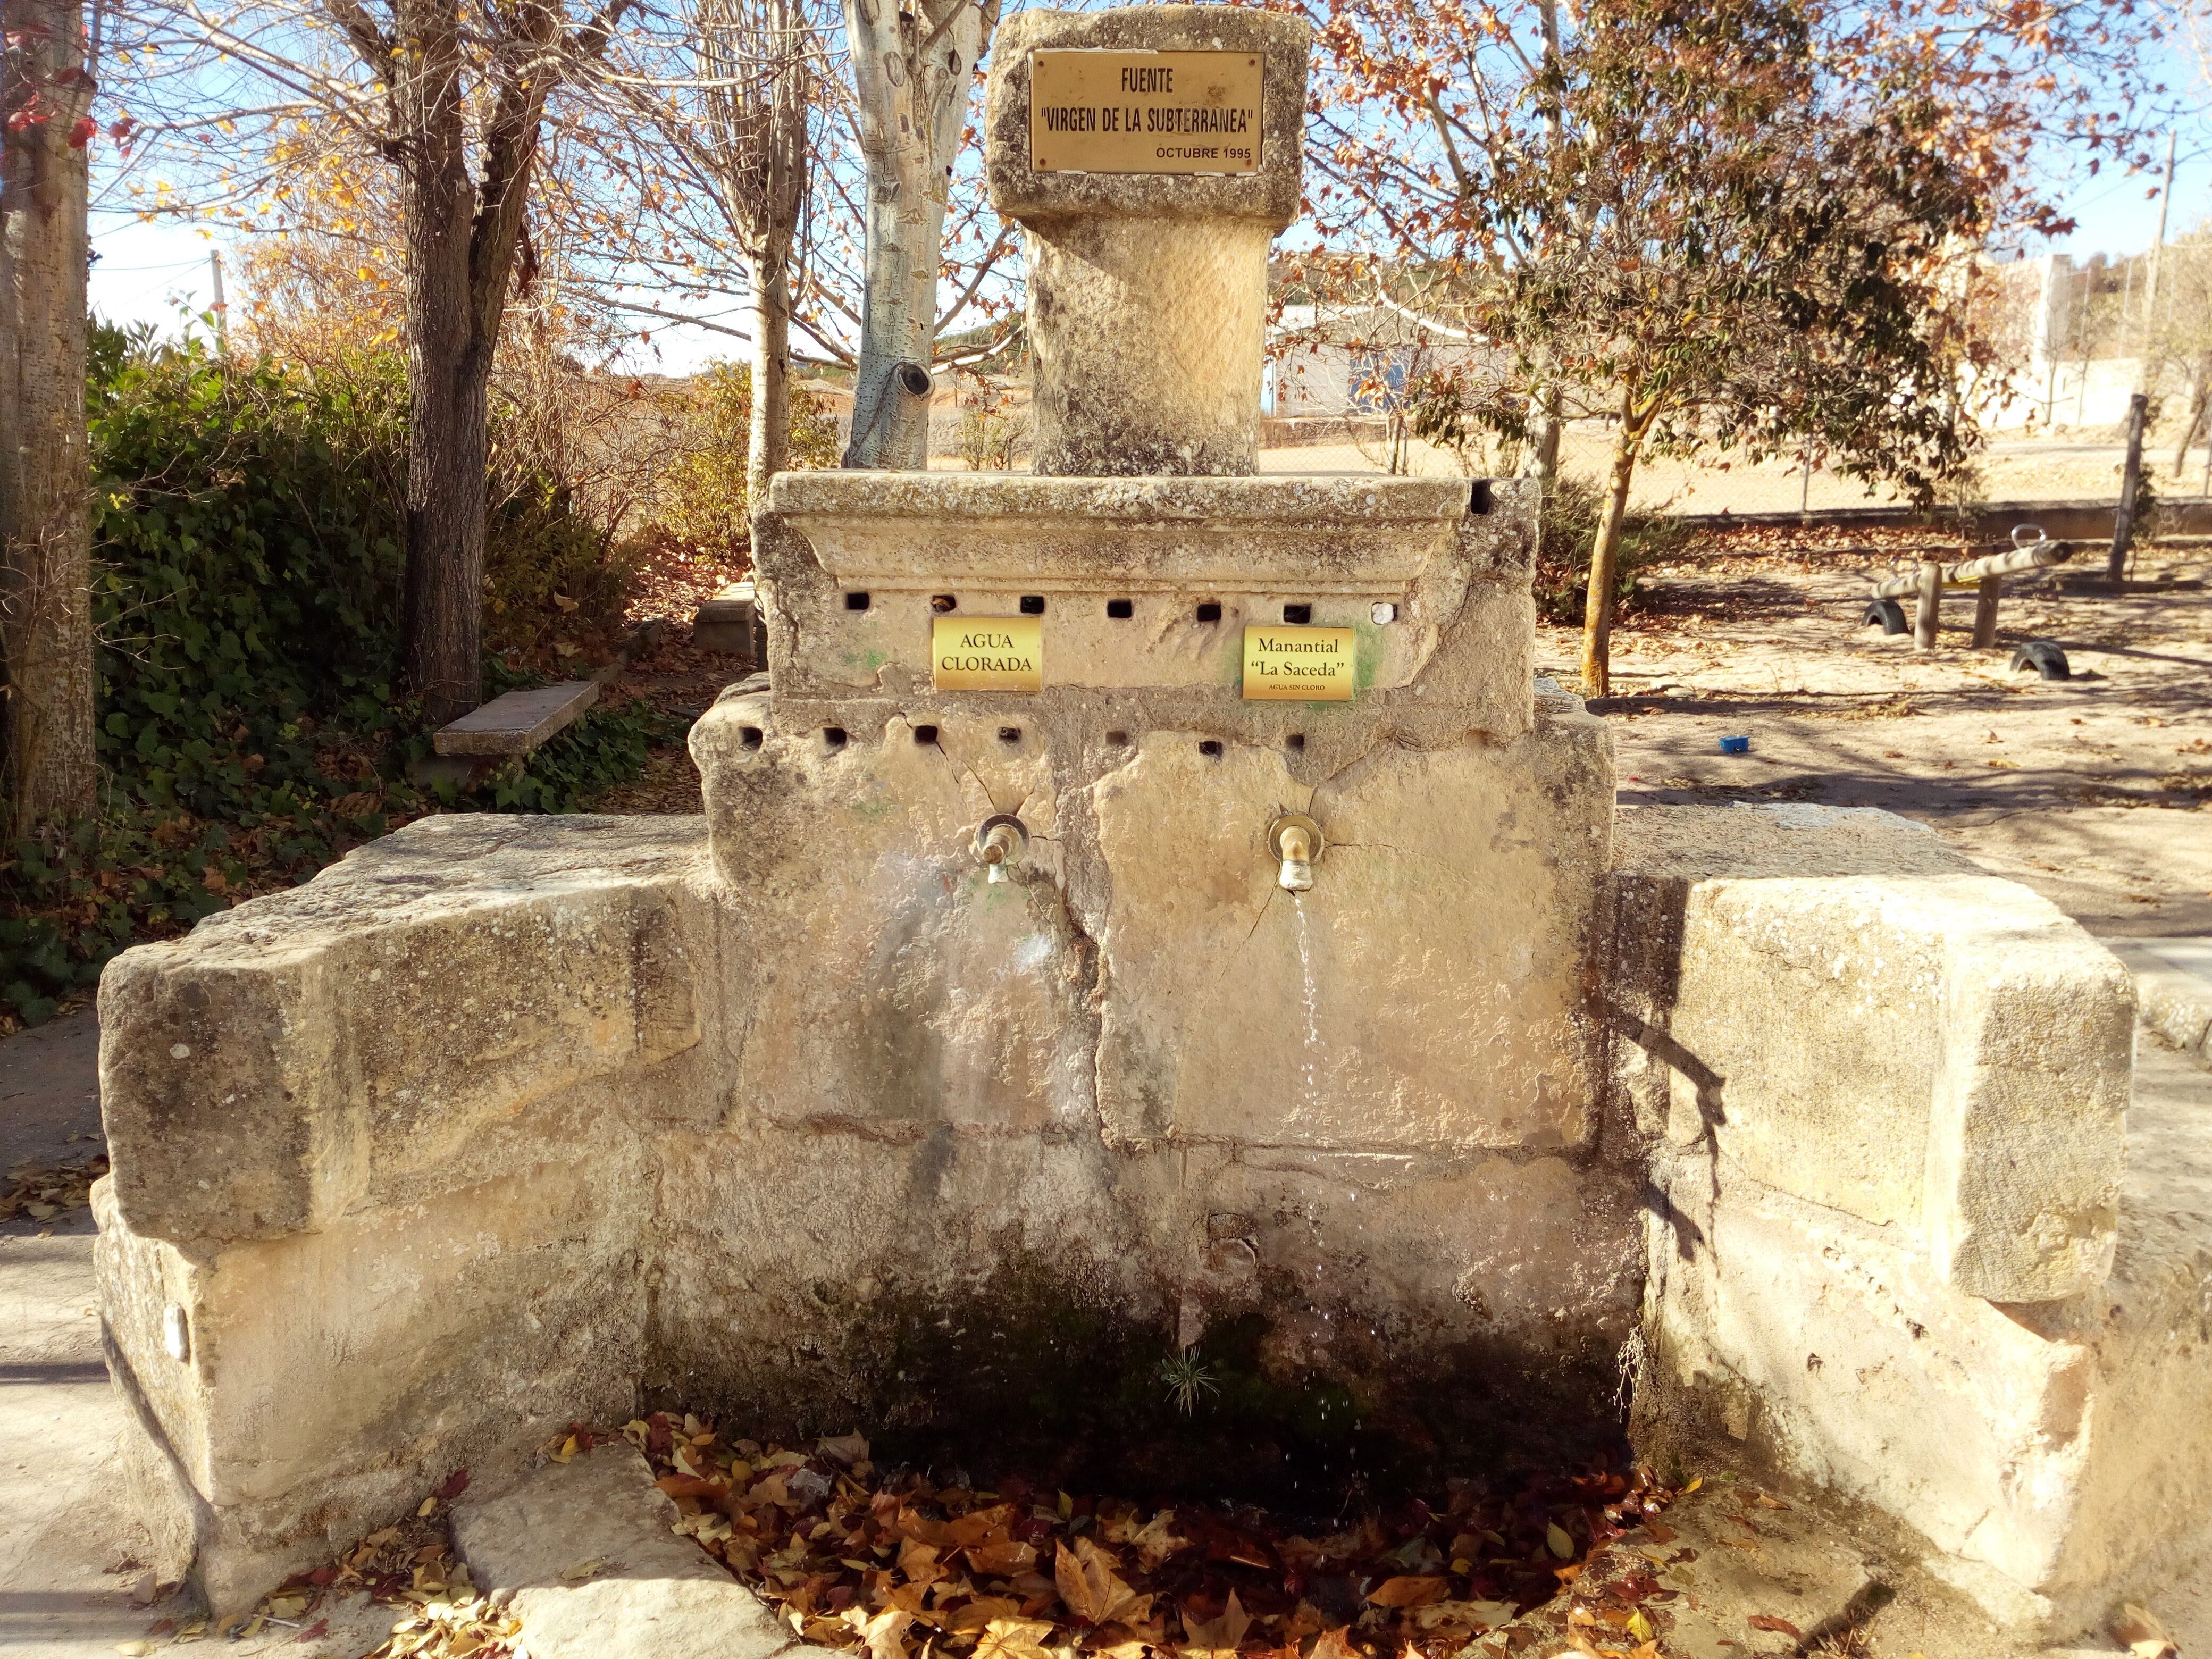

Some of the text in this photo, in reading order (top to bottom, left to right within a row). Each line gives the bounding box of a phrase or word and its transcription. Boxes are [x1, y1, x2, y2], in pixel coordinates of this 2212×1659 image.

[1121, 67, 1173, 93] FUENTE
[1041, 107, 1253, 133] "VIRGEN DE LA SUBTERRANEA"
[1156, 147, 1251, 158] OCTUBRE 1995
[960, 633, 1015, 648] AGUA
[1258, 638, 1338, 653] Manantial
[942, 656, 1032, 672] CLORADA
[1251, 661, 1344, 676] “La Saceda”
